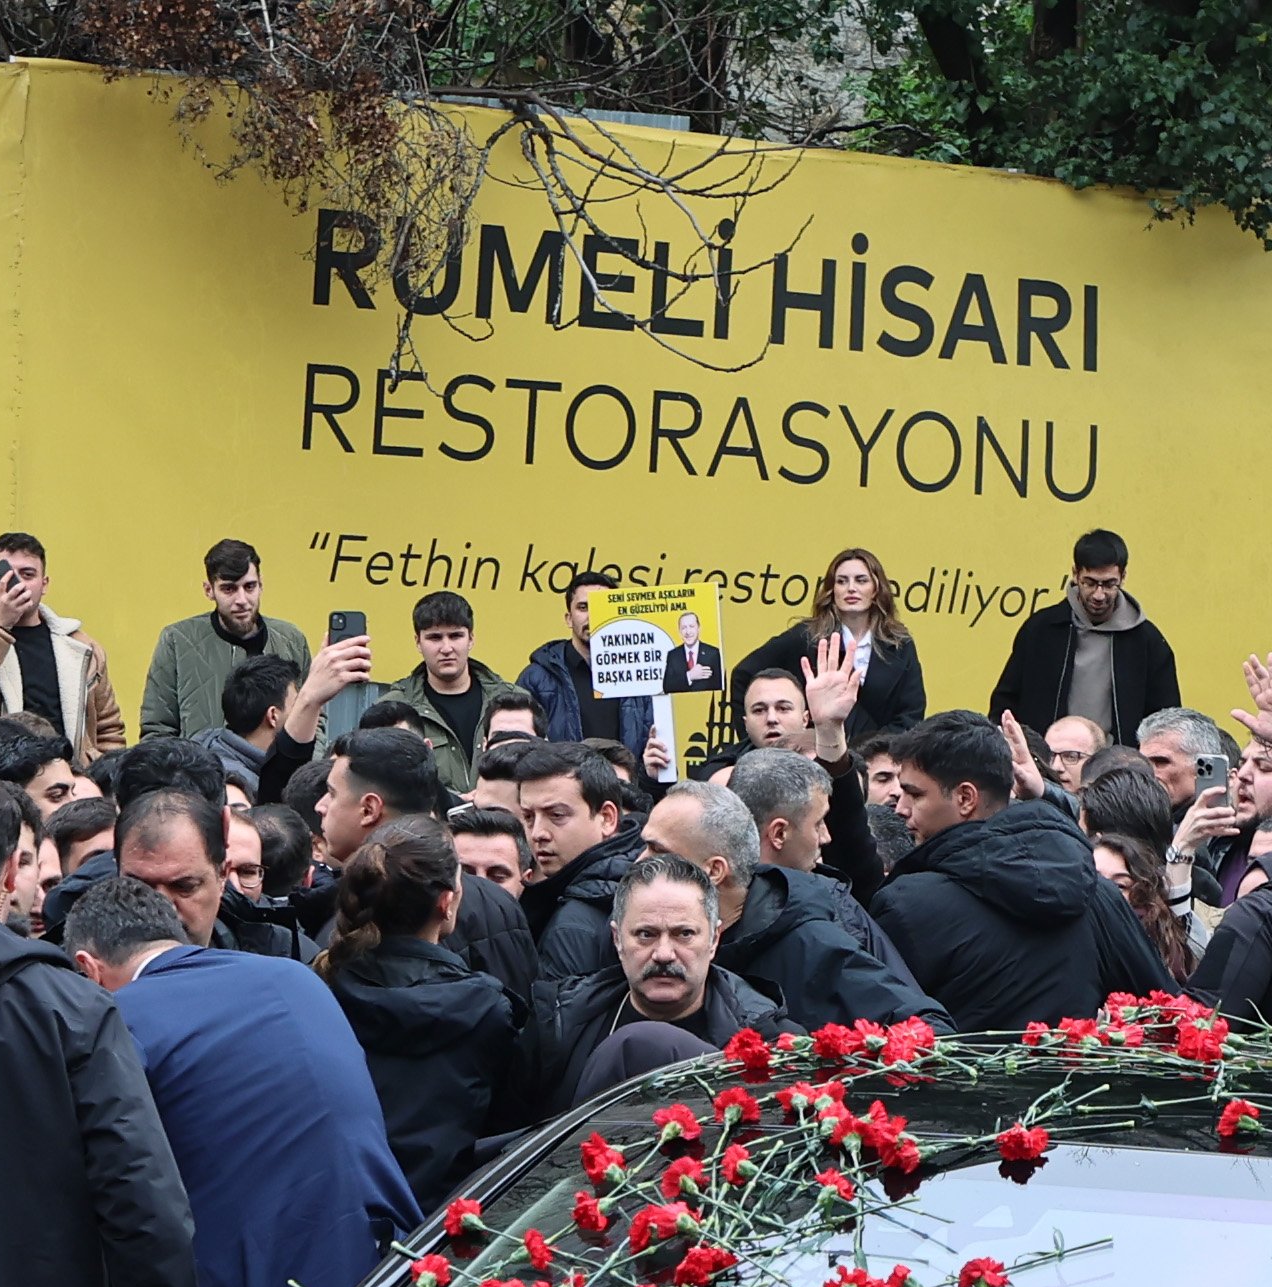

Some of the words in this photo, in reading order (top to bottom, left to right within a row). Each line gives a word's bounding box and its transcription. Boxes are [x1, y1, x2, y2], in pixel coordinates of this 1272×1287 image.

[313, 208, 736, 341] RUMELİ
[769, 232, 1099, 373] HİSARI
[302, 363, 1098, 503] RESTORASYONU
[627, 590, 657, 602] SEVMEK
[617, 605, 628, 615] EN
[670, 602, 688, 611] AMA
[601, 632, 655, 648] YAKINDAN
[596, 651, 641, 666] GÖRMEK
[644, 647, 662, 663] BİR
[597, 670, 633, 686] BAŞKA
[636, 667, 663, 682] REİS!
